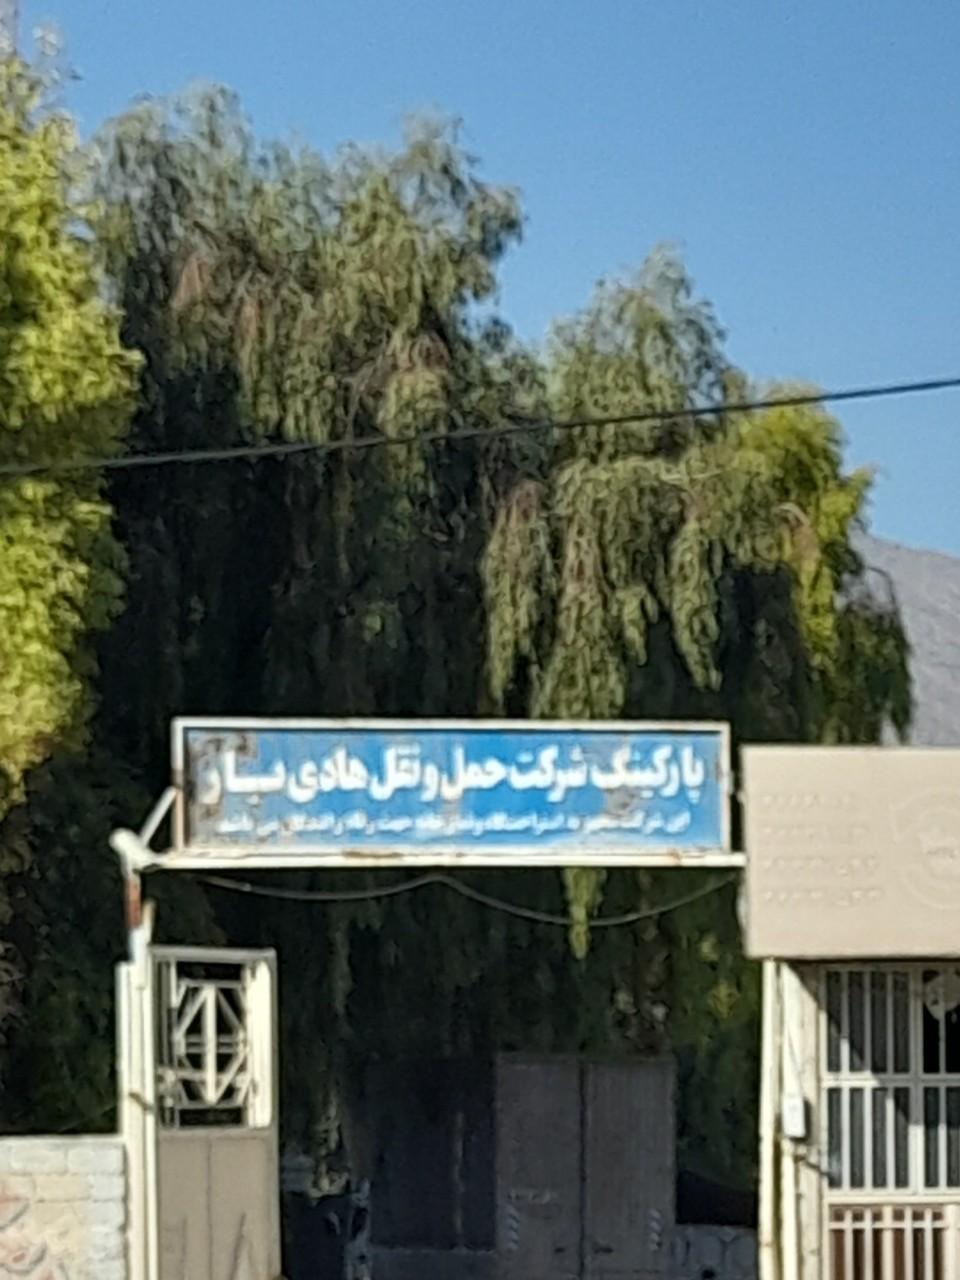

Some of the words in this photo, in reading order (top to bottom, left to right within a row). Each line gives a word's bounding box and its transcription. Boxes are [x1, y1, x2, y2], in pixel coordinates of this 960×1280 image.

[287, 745, 369, 803] هادی
[368, 743, 421, 801] نقل
[440, 743, 506, 800] حمل
[509, 745, 588, 803] شرکت
